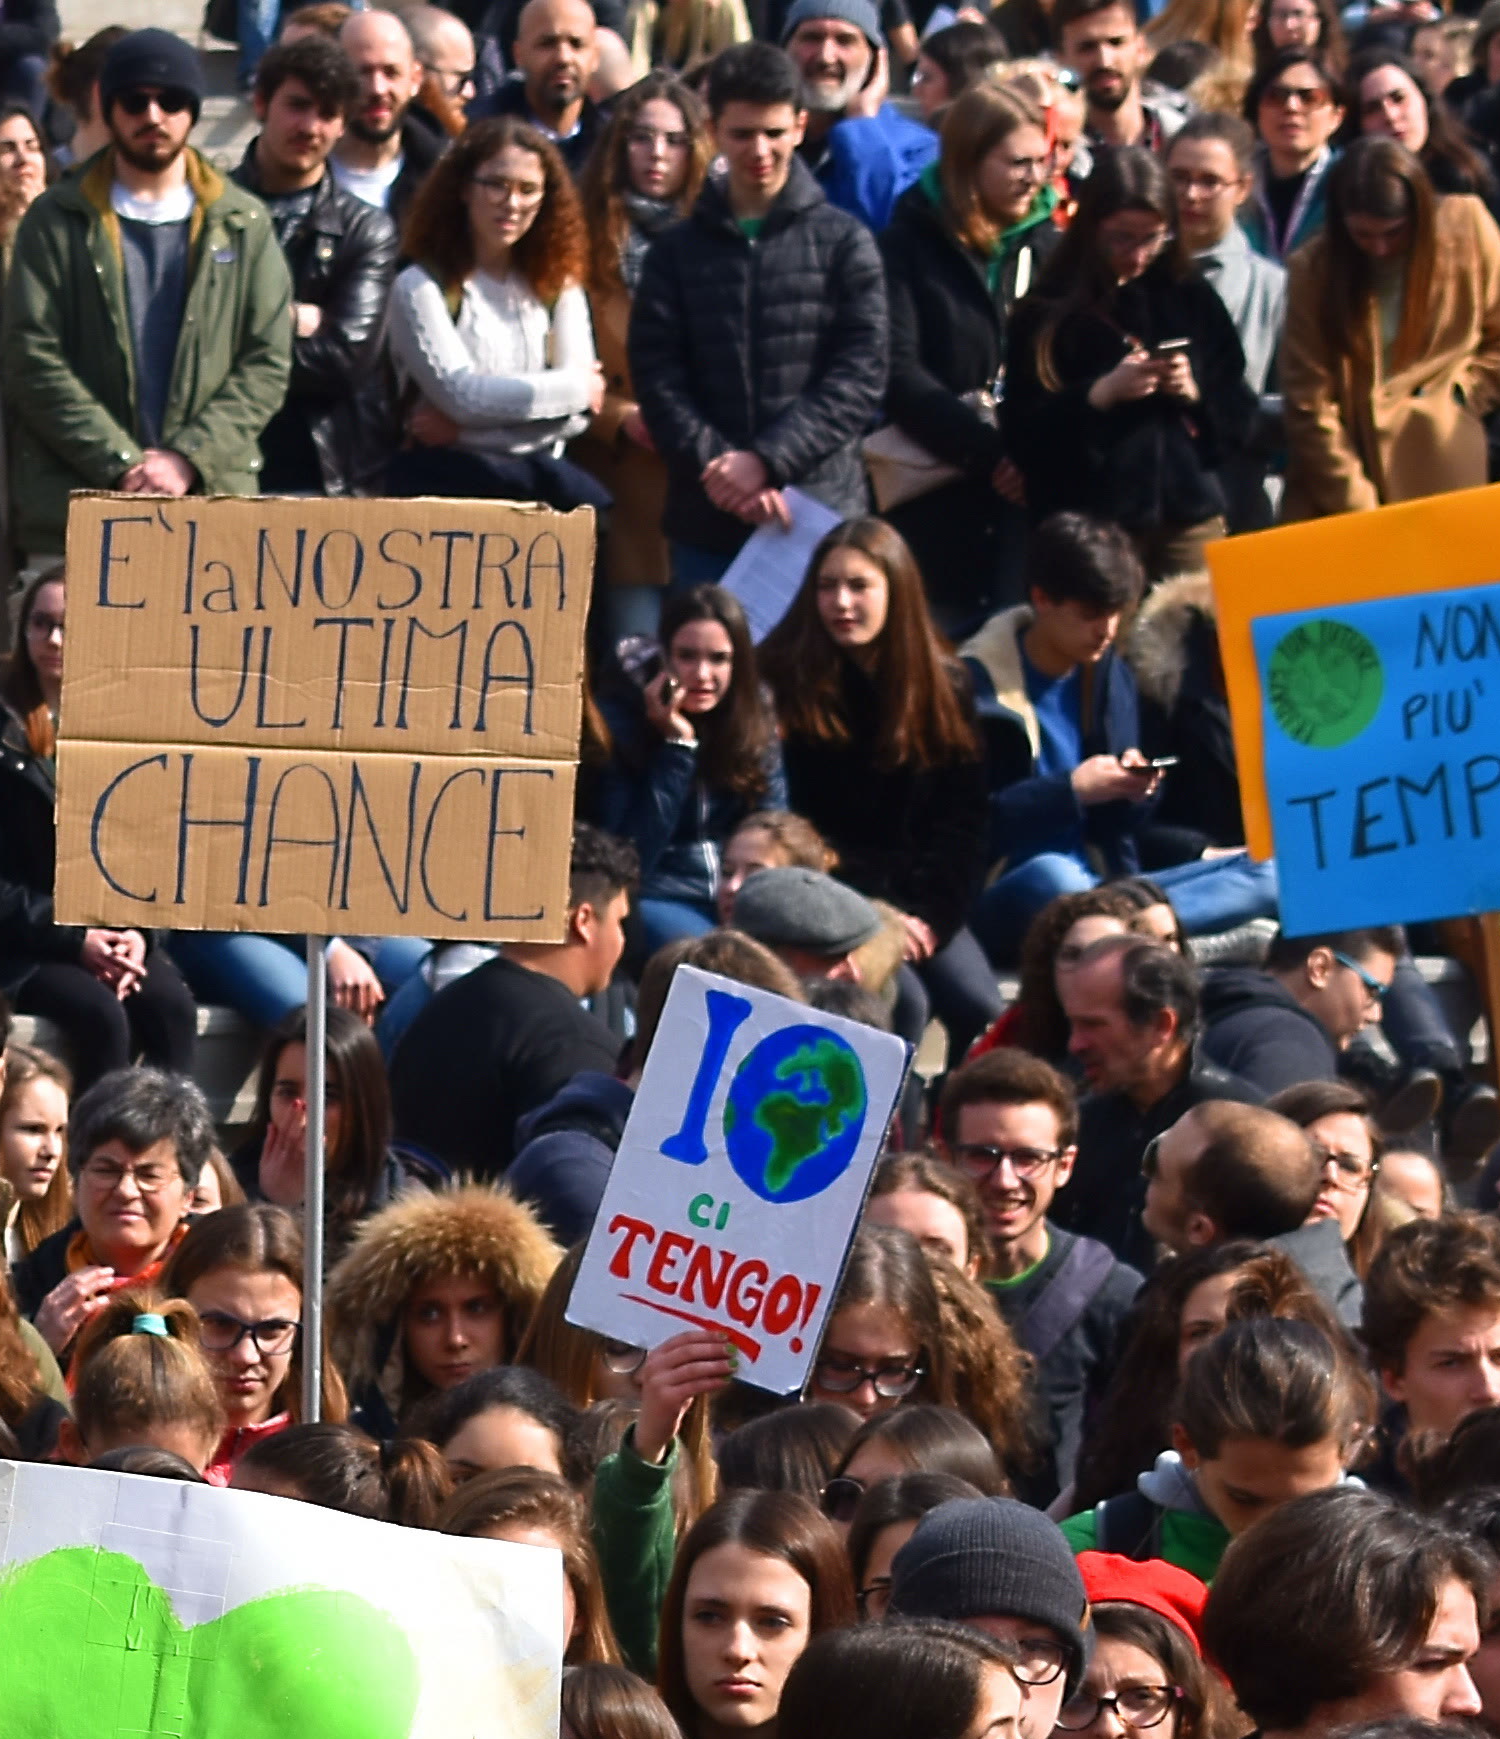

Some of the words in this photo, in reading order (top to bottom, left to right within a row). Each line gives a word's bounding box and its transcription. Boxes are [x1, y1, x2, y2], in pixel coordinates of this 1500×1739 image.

[254, 529, 566, 611] NOSTRA
[190, 616, 536, 735] ULTIMA
[91, 753, 554, 921] CHANCE
[687, 1193, 731, 1230] CI
[608, 1213, 821, 1354] TENGO!
